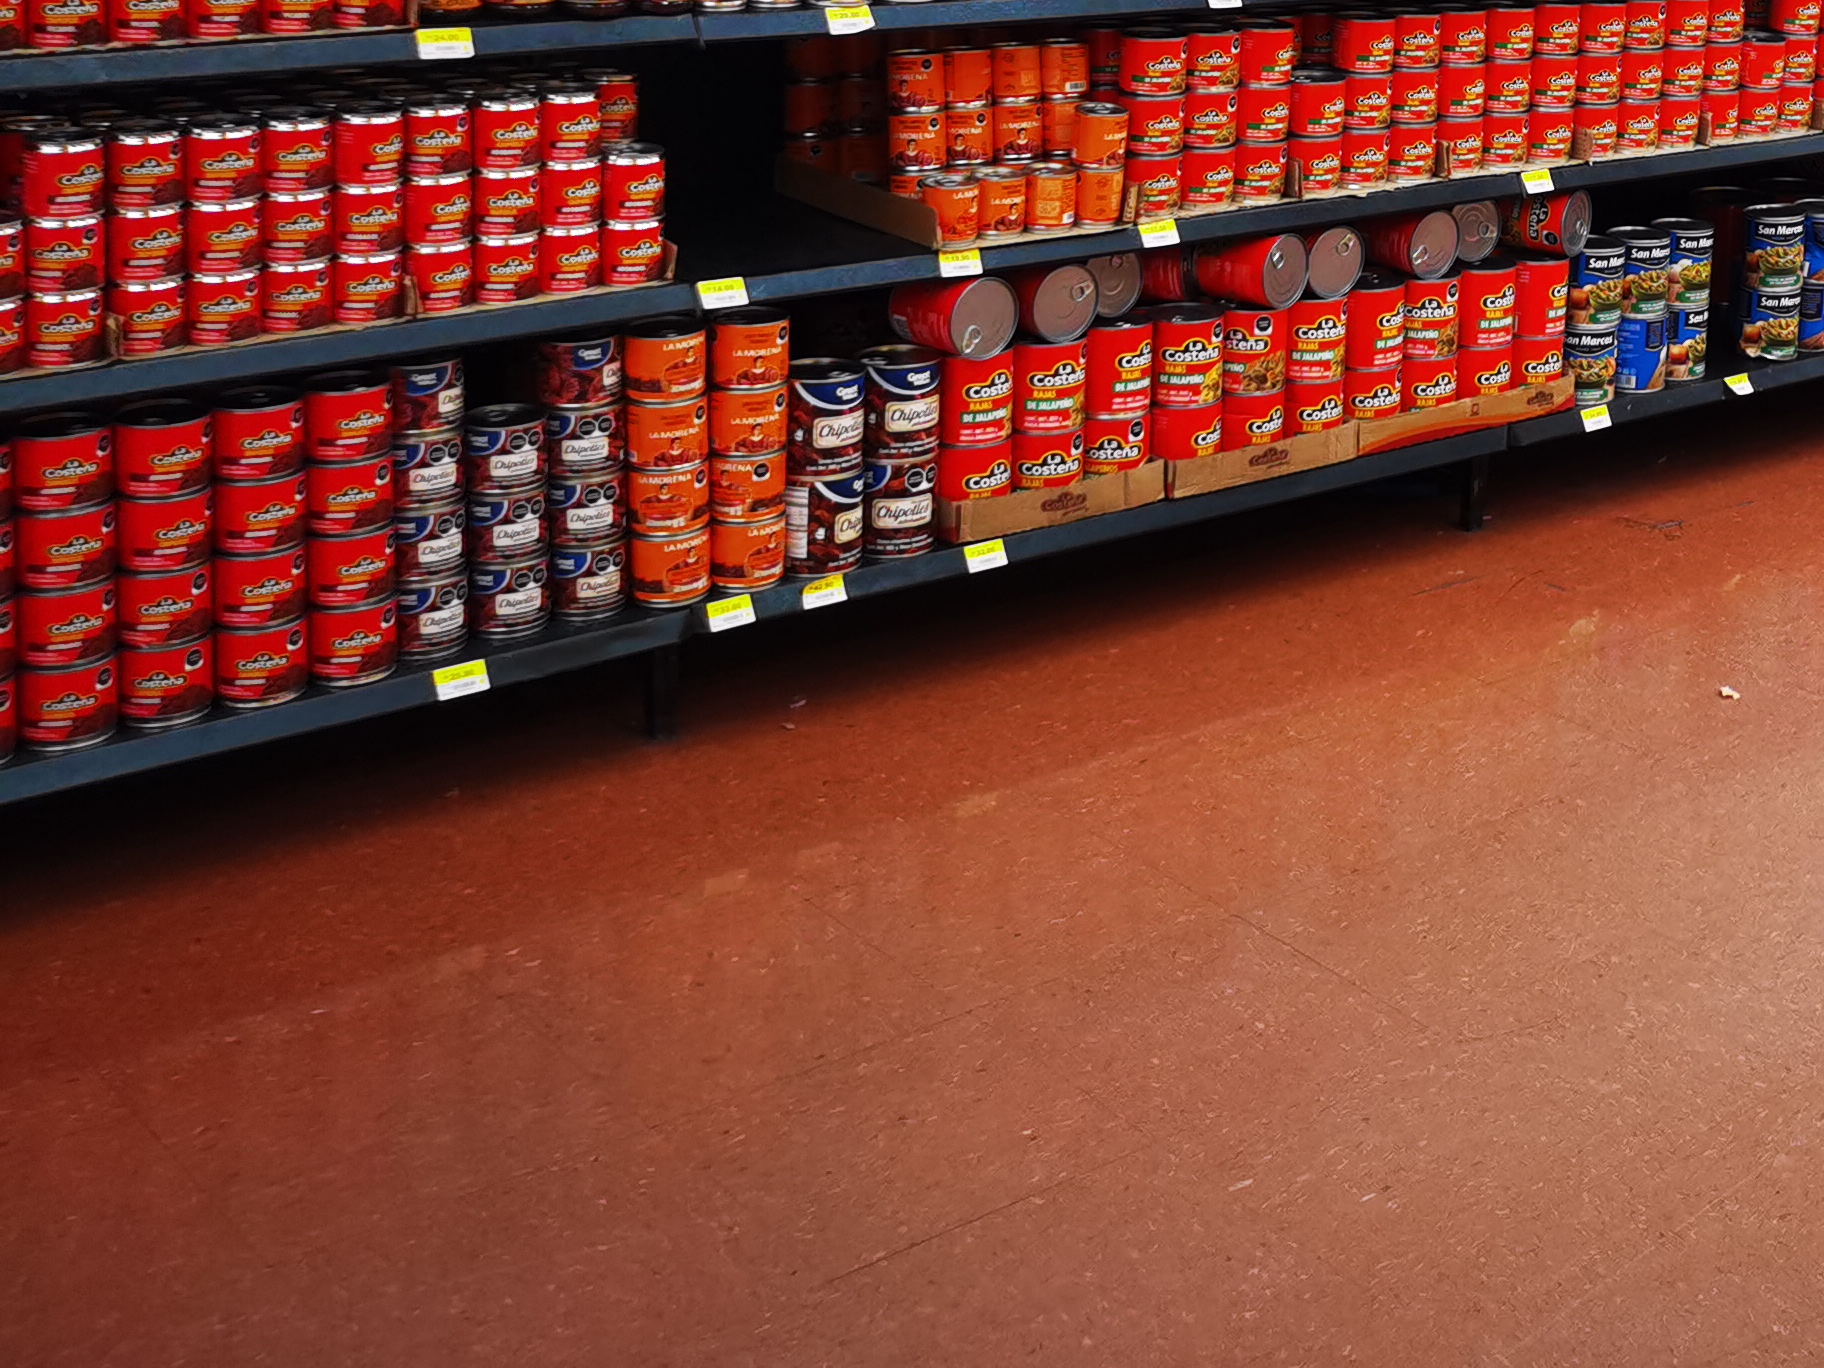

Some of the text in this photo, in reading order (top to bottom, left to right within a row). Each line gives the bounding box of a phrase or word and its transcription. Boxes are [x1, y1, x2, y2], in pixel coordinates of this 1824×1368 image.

[1758, 226, 1775, 234] San
[1681, 239, 1697, 248] San
[1631, 249, 1650, 258] San
[1589, 259, 1606, 268] San
[1425, 300, 1437, 308] La
[1762, 297, 1778, 306] San
[1405, 305, 1454, 317] Costeña
[1322, 319, 1333, 328] La
[1189, 342, 1202, 351] La
[1165, 348, 1219, 361] Costeña
[1058, 365, 1070, 374] La
[1165, 365, 1186, 373] RAJAS
[994, 374, 1006, 383] La
[1034, 390, 1056, 398] RAJAS
[1377, 389, 1389, 397] La
[970, 401, 992, 410] RAJAS
[1104, 440, 1118, 449] La
[1047, 456, 1060, 464] La
[1022, 458, 1078, 474] Costeña
